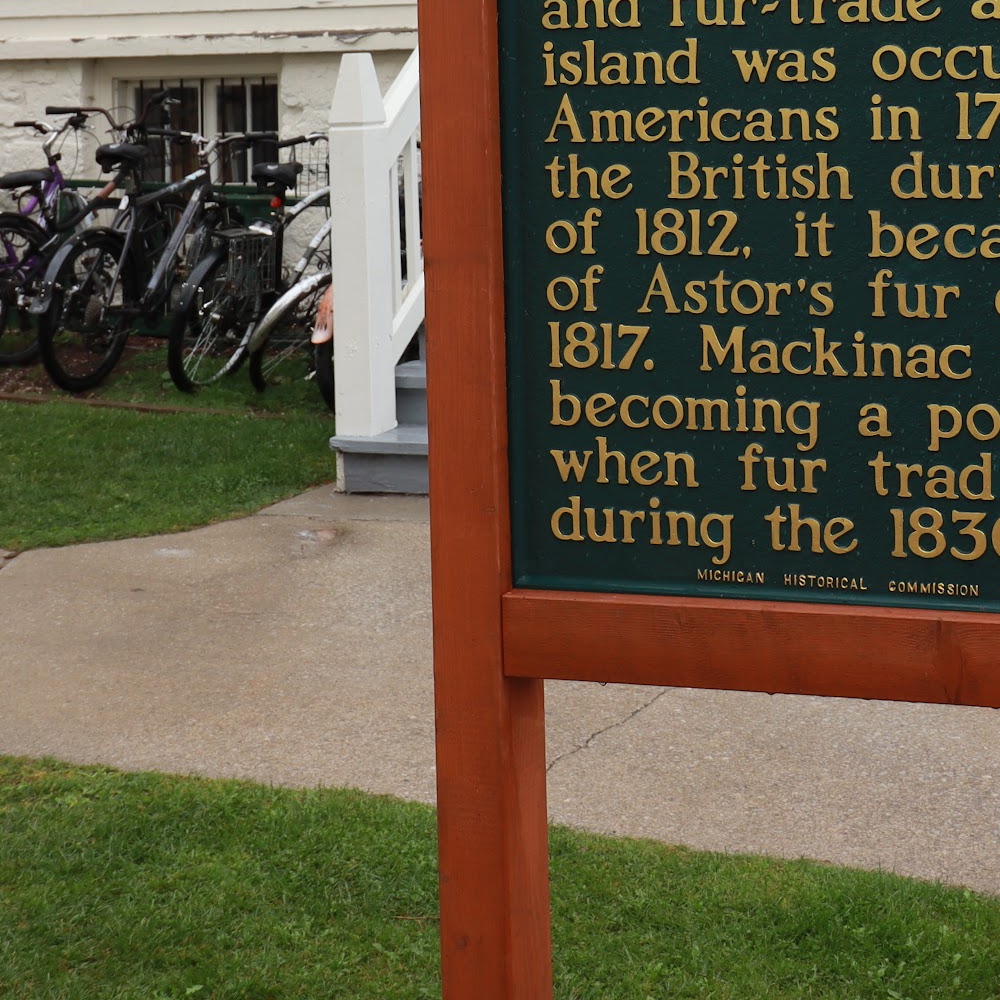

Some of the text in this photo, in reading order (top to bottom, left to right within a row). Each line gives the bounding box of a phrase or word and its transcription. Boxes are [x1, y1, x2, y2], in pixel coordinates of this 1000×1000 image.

[543, 38, 700, 85] island
[732, 48, 836, 82] was
[545, 94, 839, 142] Americans
[871, 94, 921, 140] in
[545, 154, 632, 199] the
[668, 152, 852, 199] British
[546, 208, 601, 254] of
[636, 208, 750, 258] 1812,
[795, 212, 833, 257] it
[547, 265, 604, 311] of
[639, 264, 834, 316] Astor's
[868, 270, 960, 318] fur
[548, 322, 654, 370] 1817.
[700, 325, 971, 379] Mackinac
[550, 380, 820, 451] becoming
[859, 404, 891, 436] a
[550, 437, 699, 487] when
[738, 443, 826, 493] fur
[551, 496, 733, 564] during
[765, 504, 857, 554] the
[697, 568, 765, 585] MICHIGAN
[783, 573, 868, 592] HISTORICAL
[888, 580, 979, 597] COMMISSION
